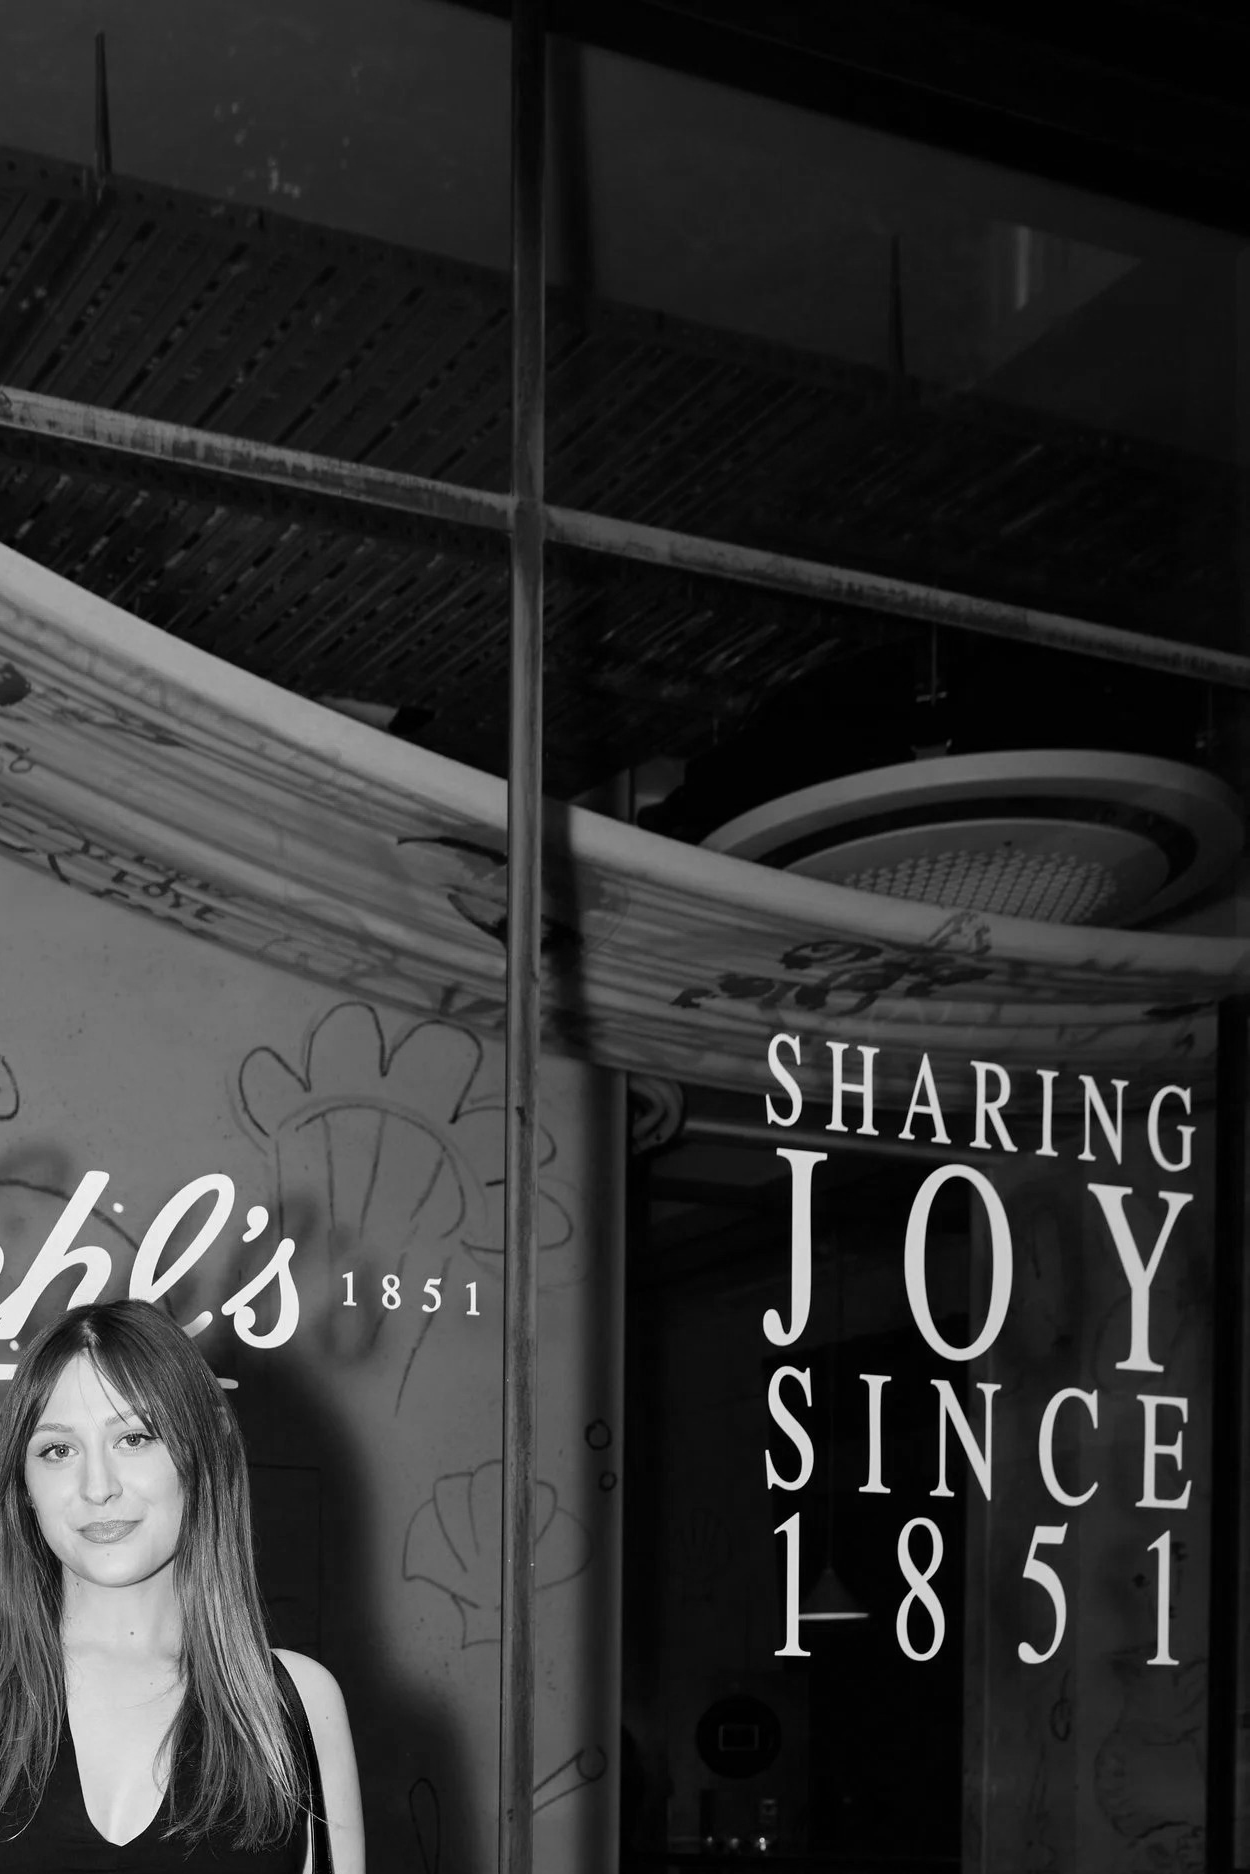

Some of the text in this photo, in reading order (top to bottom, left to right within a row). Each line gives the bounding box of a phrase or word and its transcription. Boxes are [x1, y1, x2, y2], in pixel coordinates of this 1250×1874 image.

[765, 1033, 1196, 1172] SHARING
[342, 1271, 481, 1316] 1851
[762, 1147, 1193, 1373] JOY
[764, 1365, 1192, 1510] SINCE
[773, 1511, 1179, 1666] 1851
